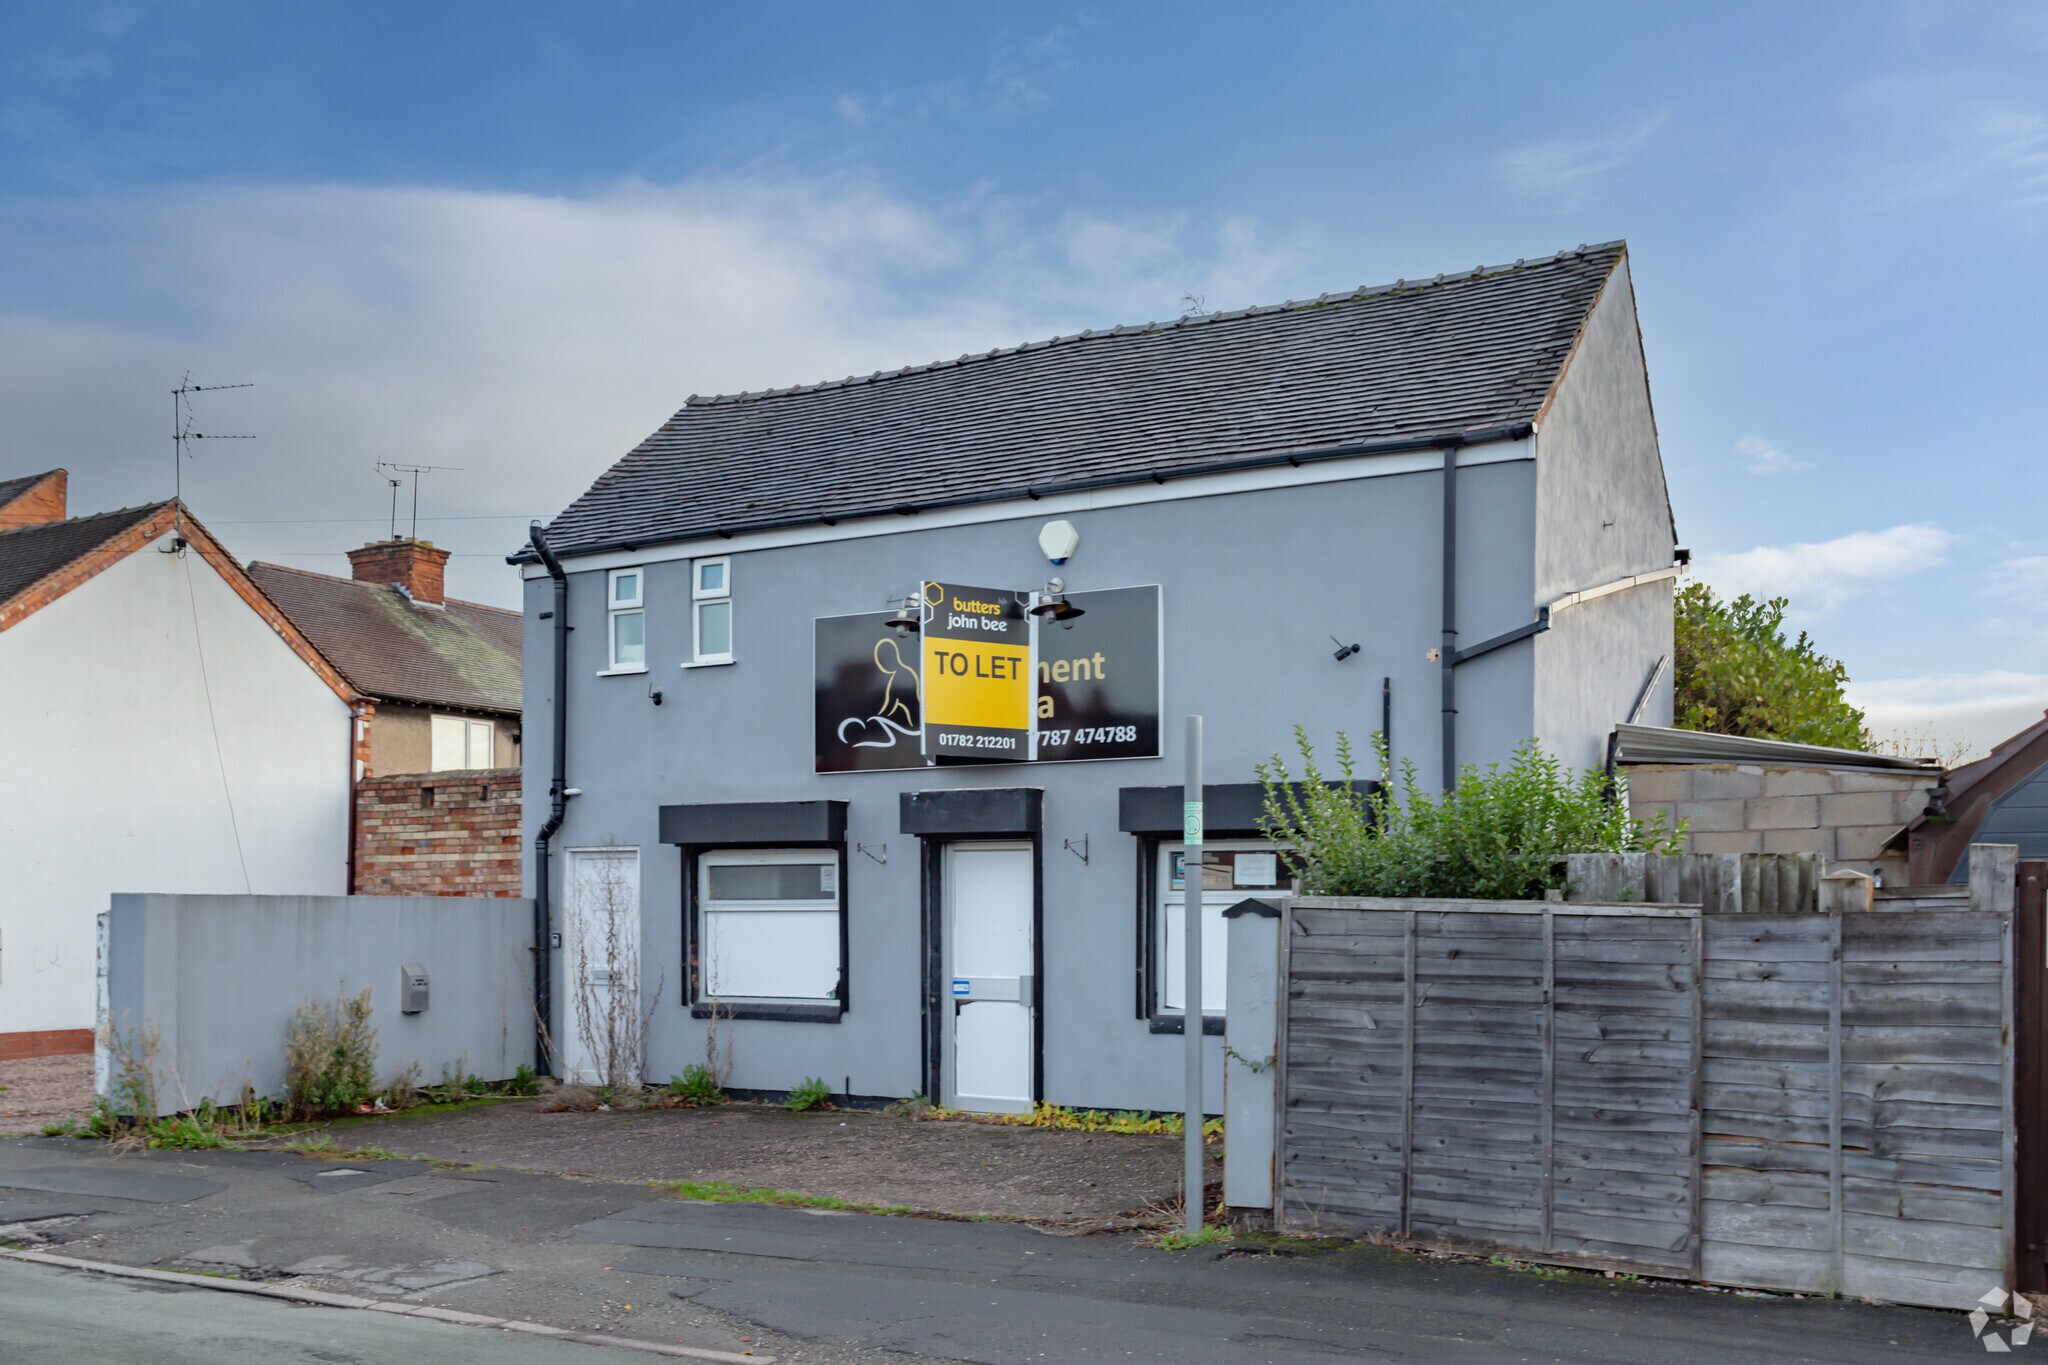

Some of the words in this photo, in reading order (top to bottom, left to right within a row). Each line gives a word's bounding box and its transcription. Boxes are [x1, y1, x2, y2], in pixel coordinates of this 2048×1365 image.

[953, 597, 1001, 615] butters
[947, 612, 978, 630] john
[981, 616, 1007, 632] bee
[934, 651, 968, 676] TO
[976, 655, 1022, 680] LET
[939, 733, 974, 747] 01782
[976, 735, 1016, 749] 212201
[1074, 725, 1137, 744] 474788
